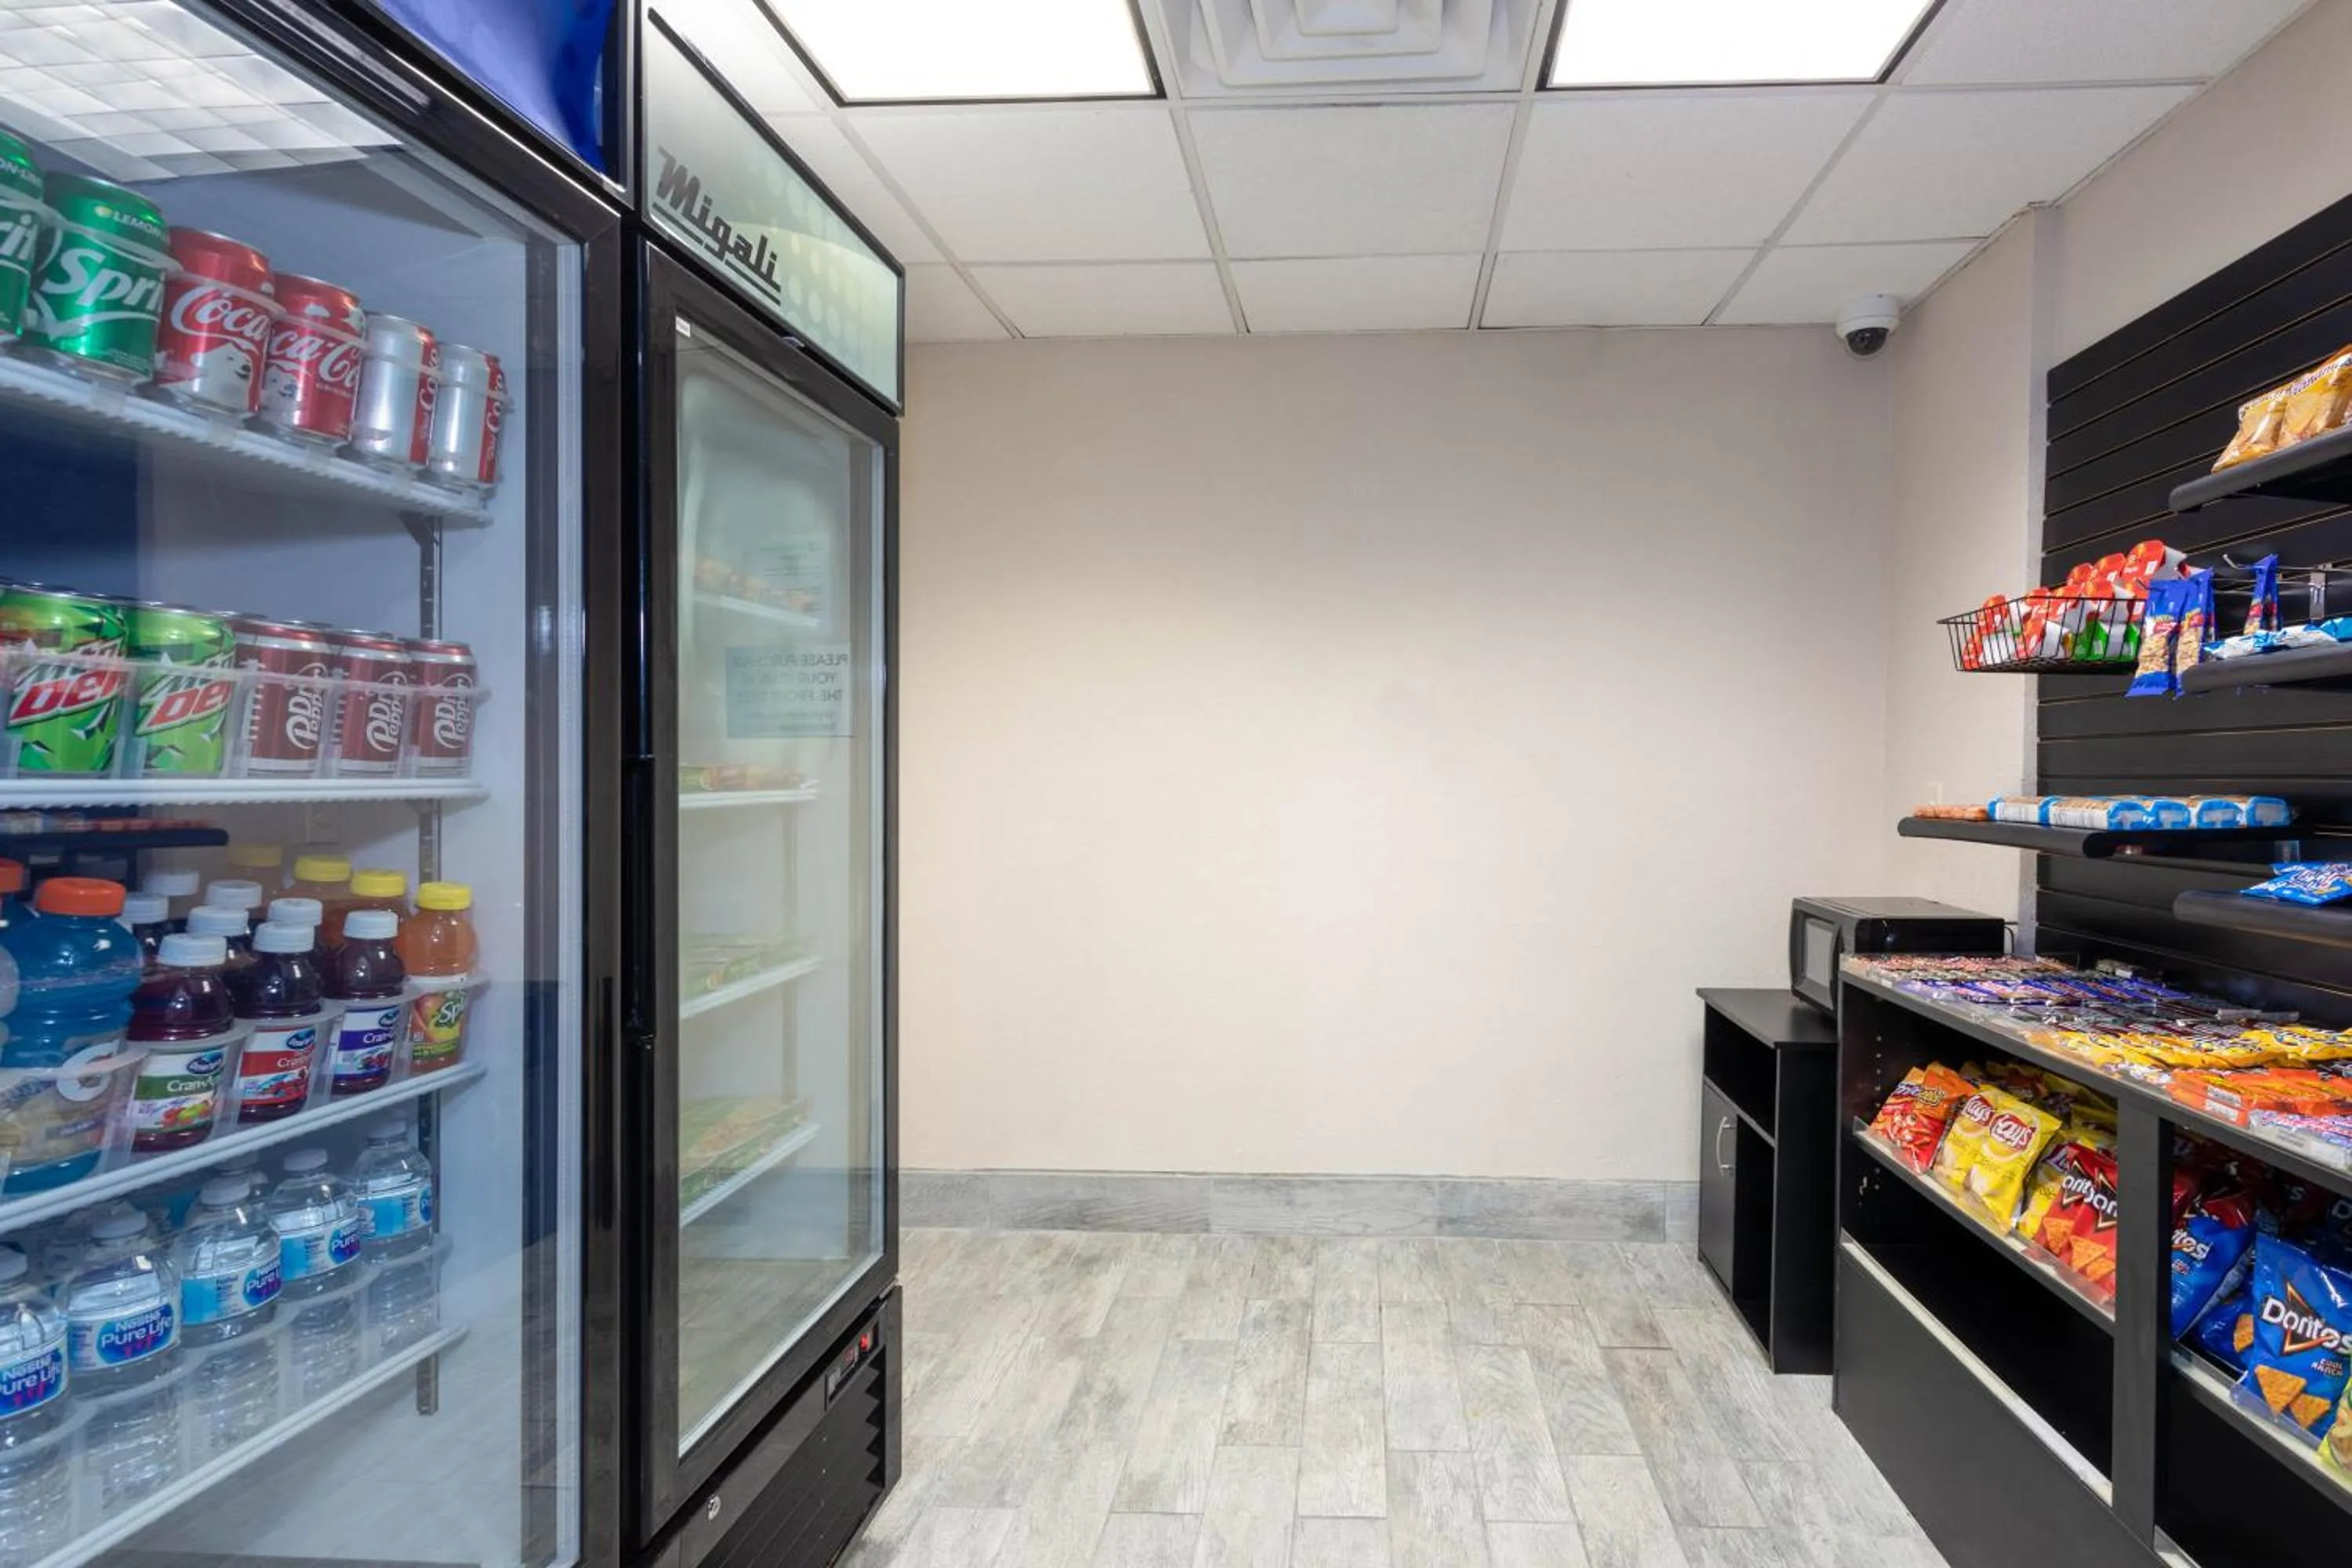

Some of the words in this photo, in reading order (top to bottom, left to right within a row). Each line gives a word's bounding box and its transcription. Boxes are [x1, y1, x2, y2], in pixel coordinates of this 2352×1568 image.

[656, 146, 781, 293] Migali
[40, 248, 163, 311] Spri
[101, 1327, 147, 1348] Pure
[0, 1374, 38, 1395] ure
